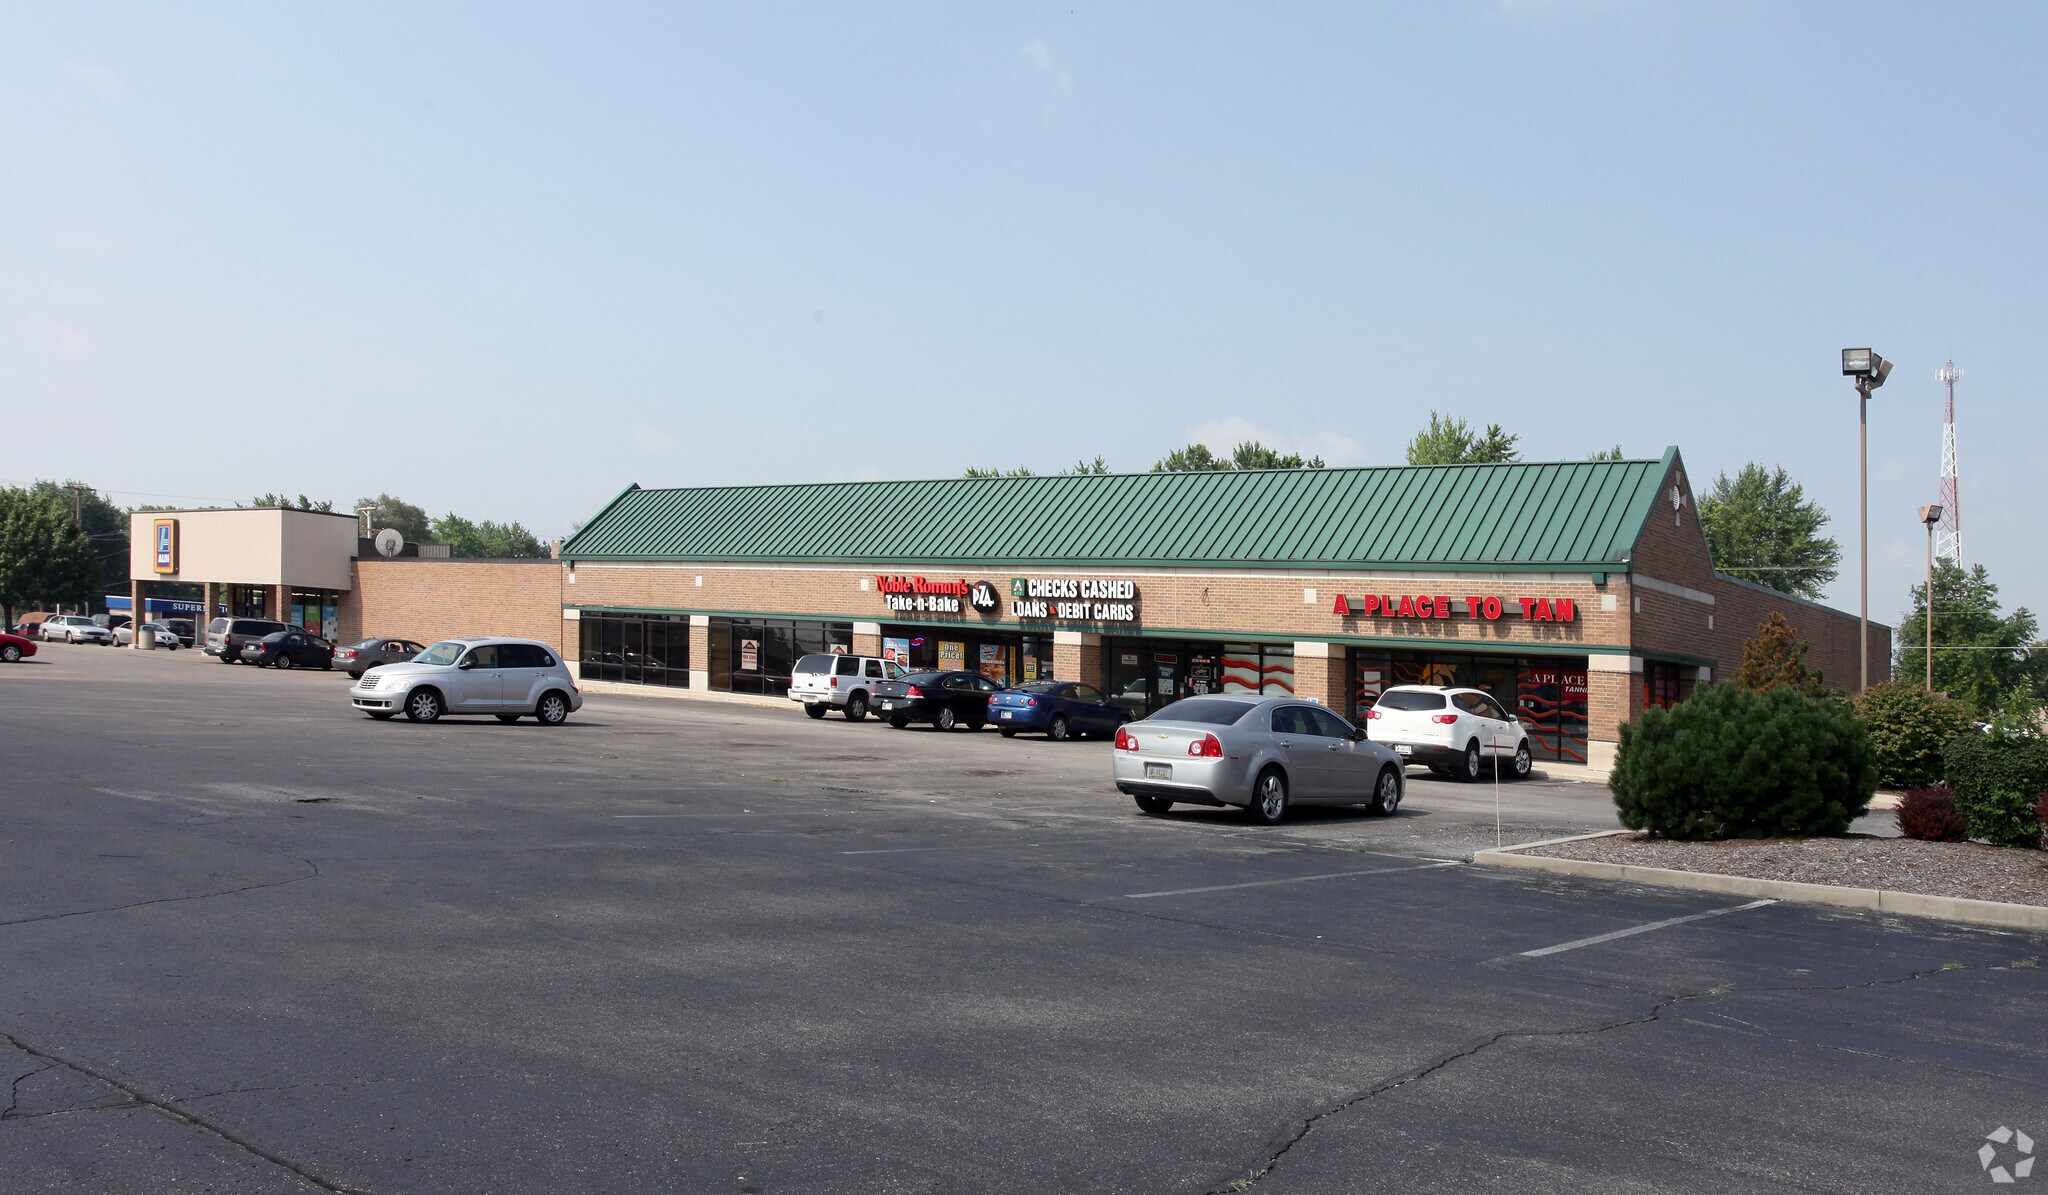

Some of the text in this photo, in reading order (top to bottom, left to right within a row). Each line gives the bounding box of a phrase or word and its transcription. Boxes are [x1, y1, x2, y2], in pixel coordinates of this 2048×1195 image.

[876, 576, 969, 598] Noble Roman's
[1028, 579, 1135, 599] CHECKS CASHED
[886, 594, 959, 613] Take-n-Bake
[1011, 601, 1134, 621] LOANS DEBIT CARDS
[1333, 594, 1575, 622] A PLACE TO TAN
[940, 651, 963, 660] Price!
[944, 643, 960, 651] One
[1532, 673, 1585, 686] A PLACE
